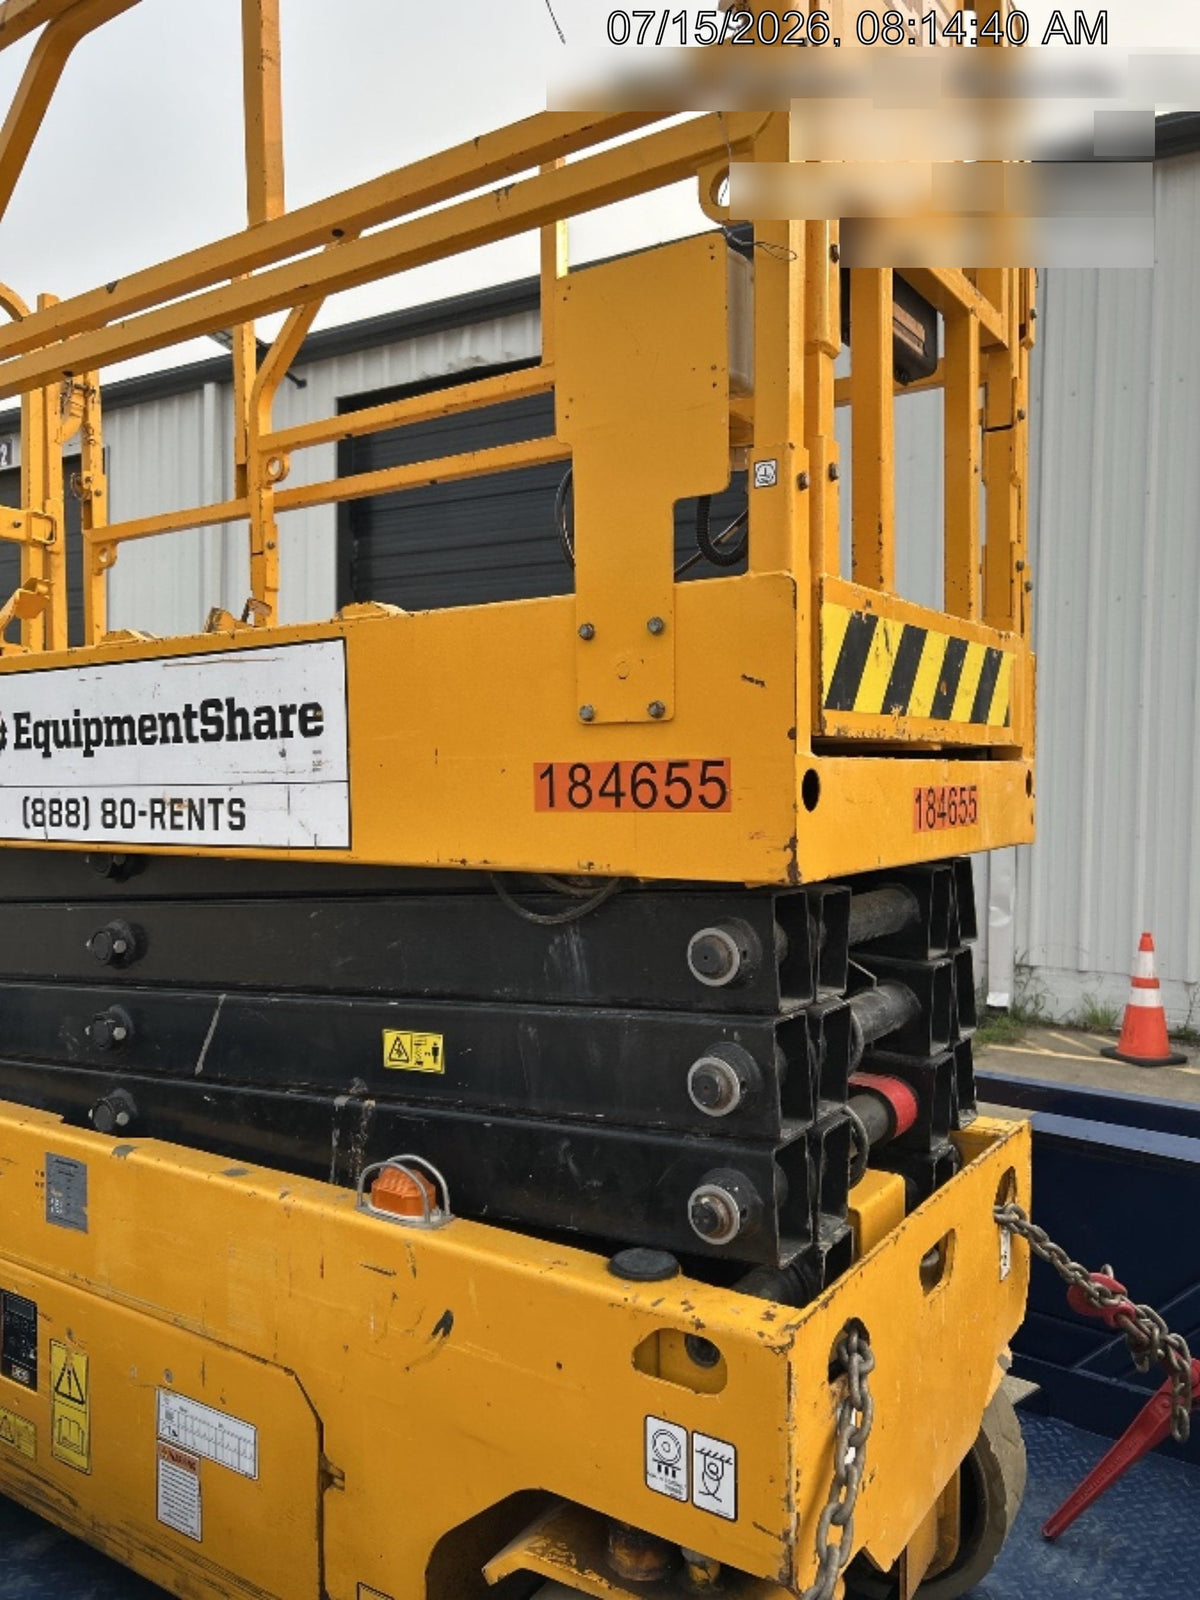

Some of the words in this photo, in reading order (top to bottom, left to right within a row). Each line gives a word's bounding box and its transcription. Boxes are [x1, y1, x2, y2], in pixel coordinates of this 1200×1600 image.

[13, 697, 324, 758] EquipmentShare
[539, 760, 728, 810] 184655
[914, 785, 978, 830] 184655
[22, 796, 90, 831] (888)
[100, 798, 247, 831] 80-RENTS
